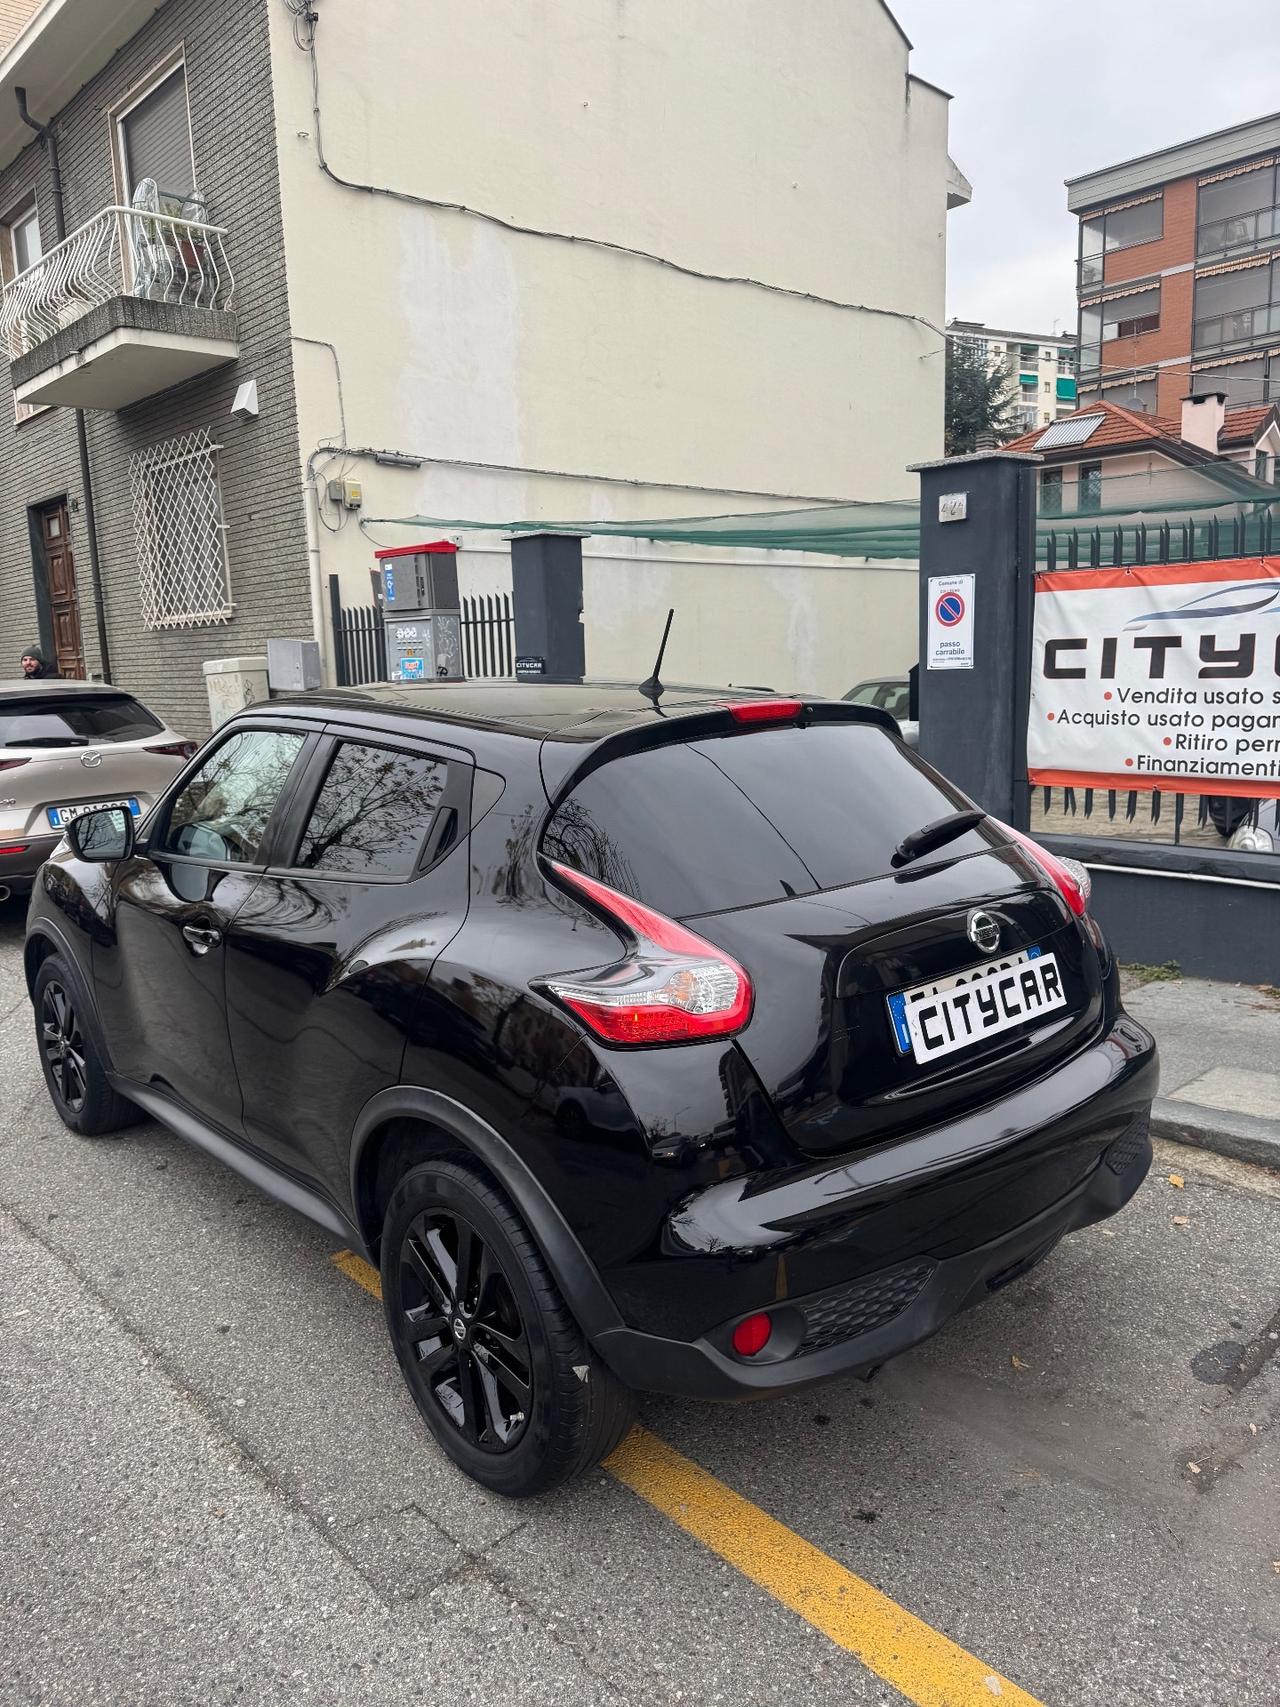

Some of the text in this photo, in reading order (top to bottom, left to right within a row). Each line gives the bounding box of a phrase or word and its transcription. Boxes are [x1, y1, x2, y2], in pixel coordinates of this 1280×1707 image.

[935, 648, 965, 656] carrabile
[939, 641, 961, 649] passo
[1043, 632, 1280, 679] CITY
[1117, 687, 1197, 704] Vendita
[1204, 687, 1264, 704] usato
[1057, 709, 1140, 728] Acquisto
[1148, 713, 1204, 727] usato
[1175, 733, 1280, 755] Ritiro per
[1137, 754, 1280, 776] Finanziamenti
[918, 962, 1062, 1050] CITYCAR
